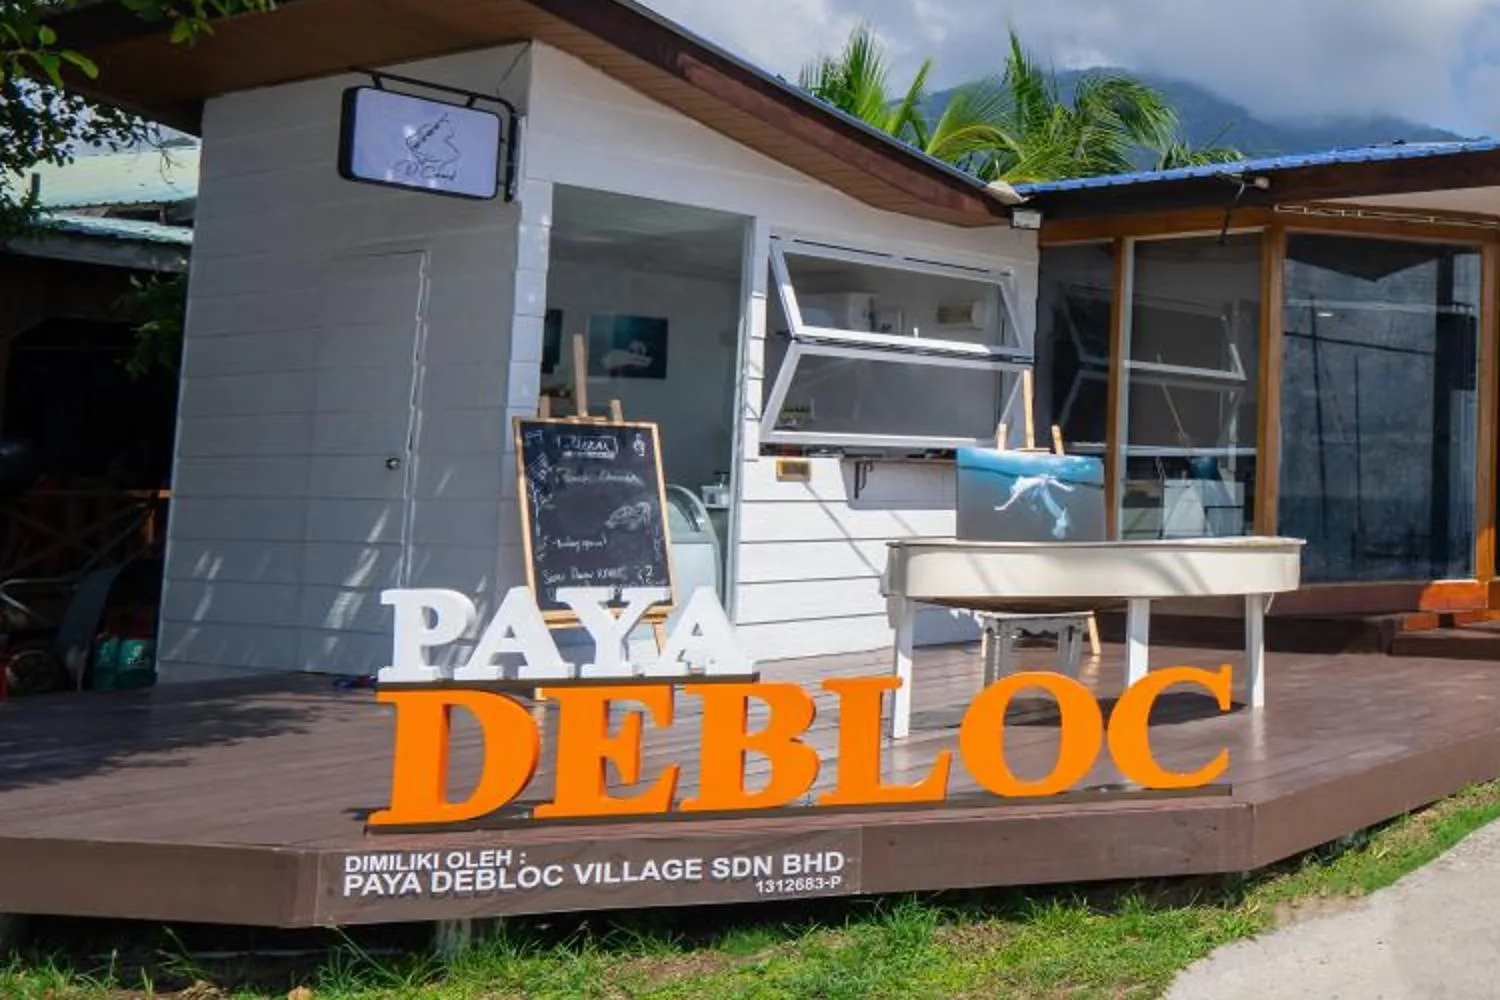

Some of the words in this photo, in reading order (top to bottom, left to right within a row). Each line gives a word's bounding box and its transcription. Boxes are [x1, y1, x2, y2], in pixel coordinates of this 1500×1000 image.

[378, 586, 756, 681] PAYA
[367, 664, 1234, 825] DEBLOC
[343, 873, 423, 897] PAYA
[431, 864, 565, 893] DEBLOC
[573, 858, 704, 885] VILLAGE
[711, 855, 773, 879] SDN
[782, 851, 844, 875] BHD
[345, 853, 440, 873] DIMILIKI
[446, 849, 512, 869] OLEH
